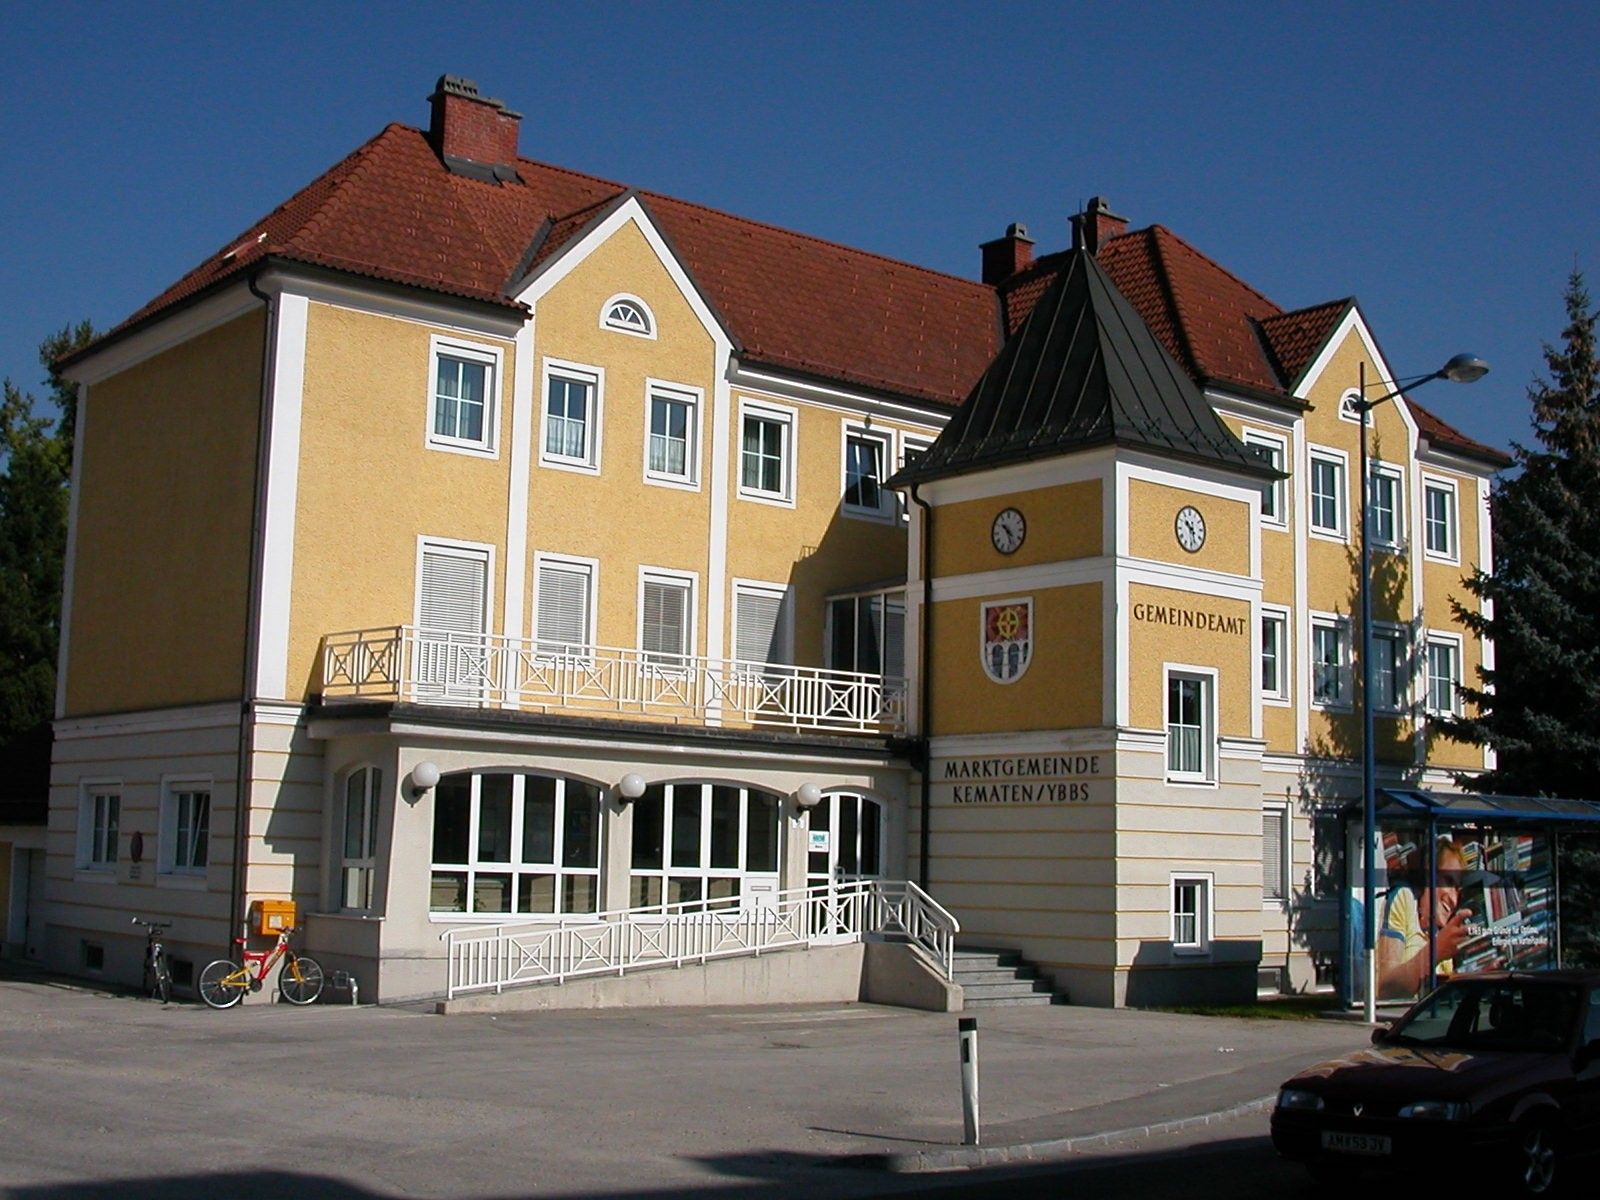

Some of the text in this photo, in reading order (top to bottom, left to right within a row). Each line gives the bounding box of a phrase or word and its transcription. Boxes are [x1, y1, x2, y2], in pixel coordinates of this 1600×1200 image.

[1133, 603, 1246, 635] GEMEINDEAMT
[944, 756, 1100, 779] MARKTGEMEINDE
[952, 783, 1090, 803] KEMATEN/YBBS
